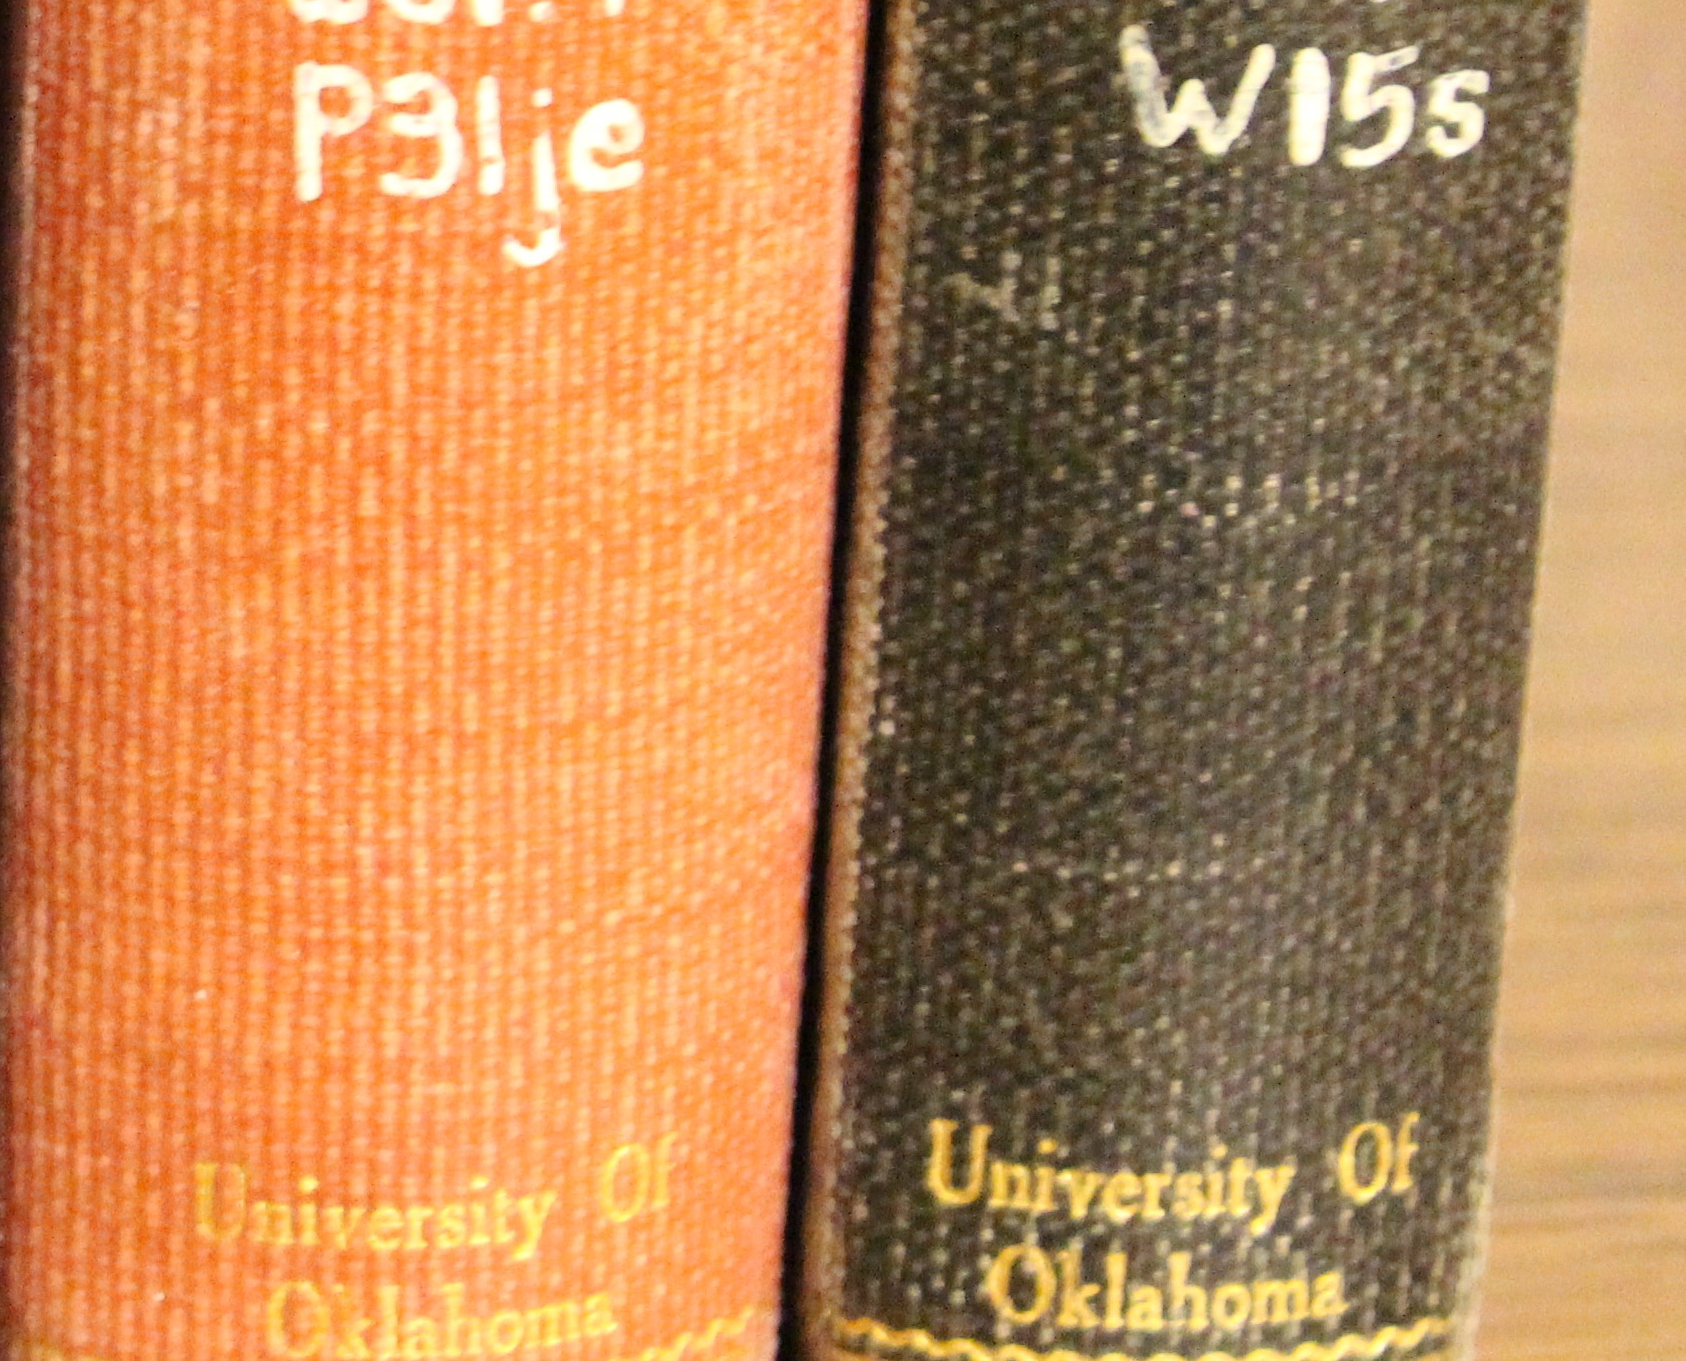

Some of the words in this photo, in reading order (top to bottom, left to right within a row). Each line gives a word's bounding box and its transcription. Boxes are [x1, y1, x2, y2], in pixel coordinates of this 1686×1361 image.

[194, 1162, 558, 1263] University
[599, 1132, 679, 1224] Of
[927, 1118, 1296, 1236] University
[1338, 1111, 1420, 1205] Of
[266, 1279, 620, 1361] Oklahoma
[988, 1242, 1352, 1332] Oklahoma
